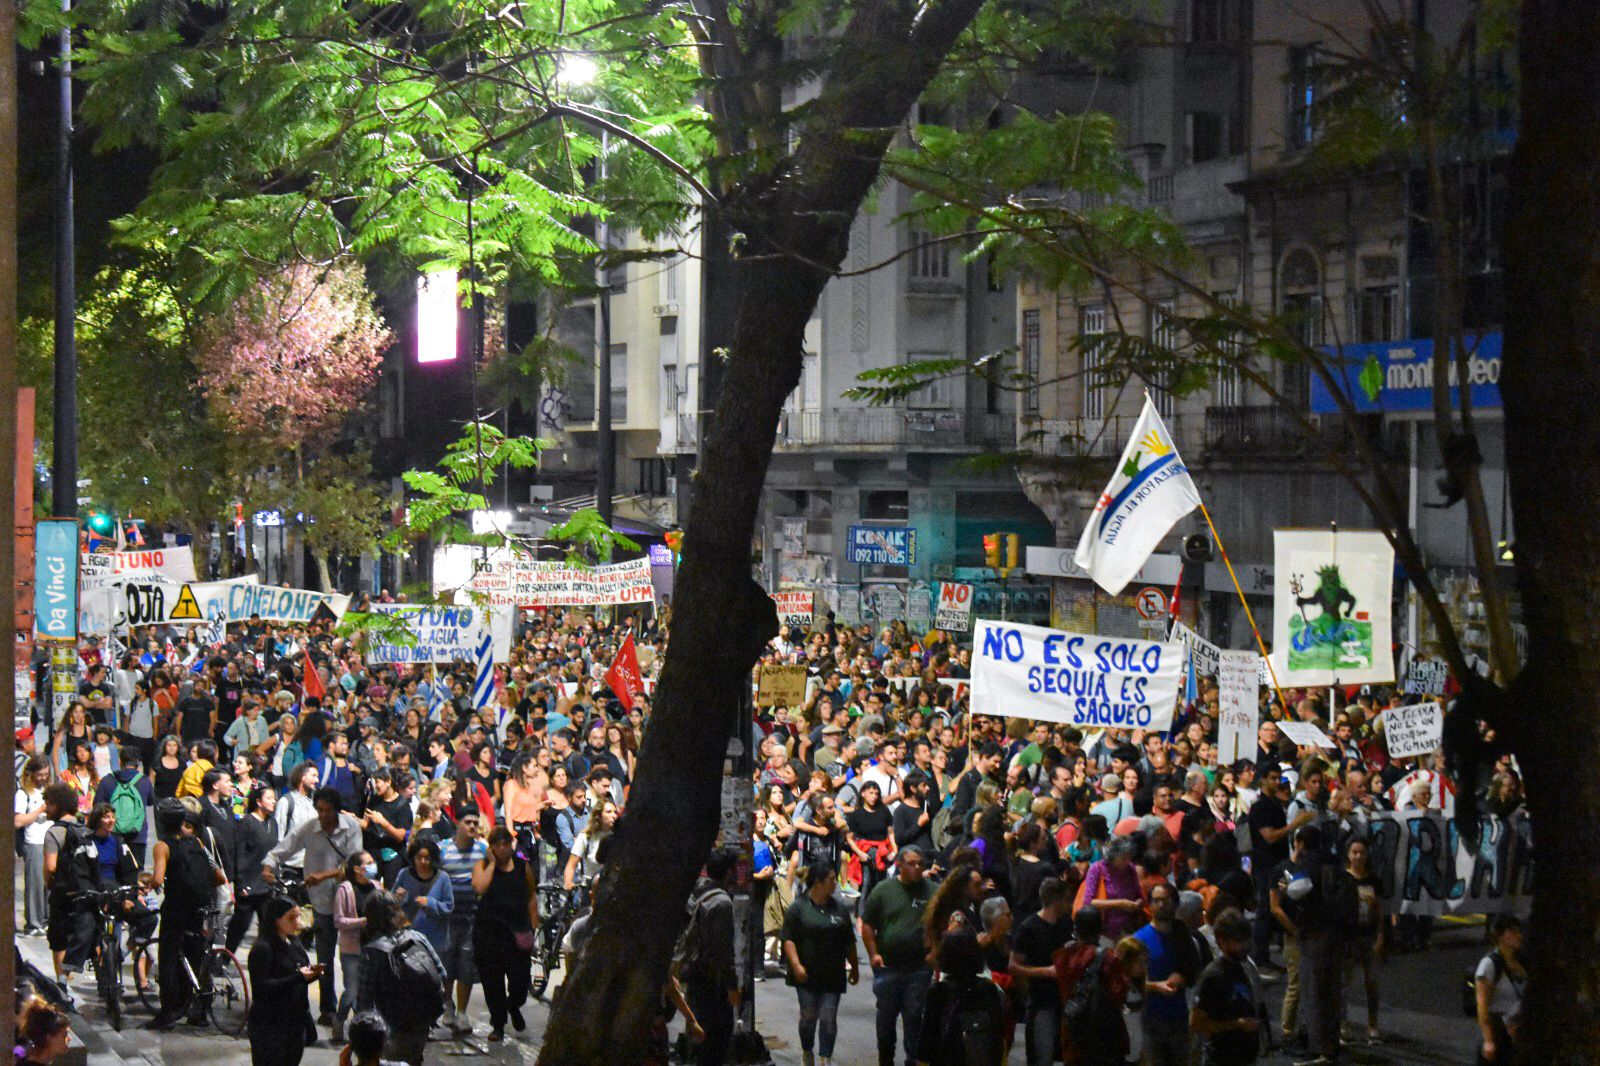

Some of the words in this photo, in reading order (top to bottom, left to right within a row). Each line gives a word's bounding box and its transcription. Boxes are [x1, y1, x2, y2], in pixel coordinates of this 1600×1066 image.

[113, 583, 164, 627] OJA
[620, 585, 652, 602] UPM
[942, 583, 969, 604] NO
[47, 608, 69, 632] Da
[982, 627, 1025, 663] NO
[1043, 634, 1084, 669] ES
[1094, 641, 1162, 674] SOLO
[1120, 676, 1148, 704] ES
[1073, 697, 1152, 727] SAQUEO
